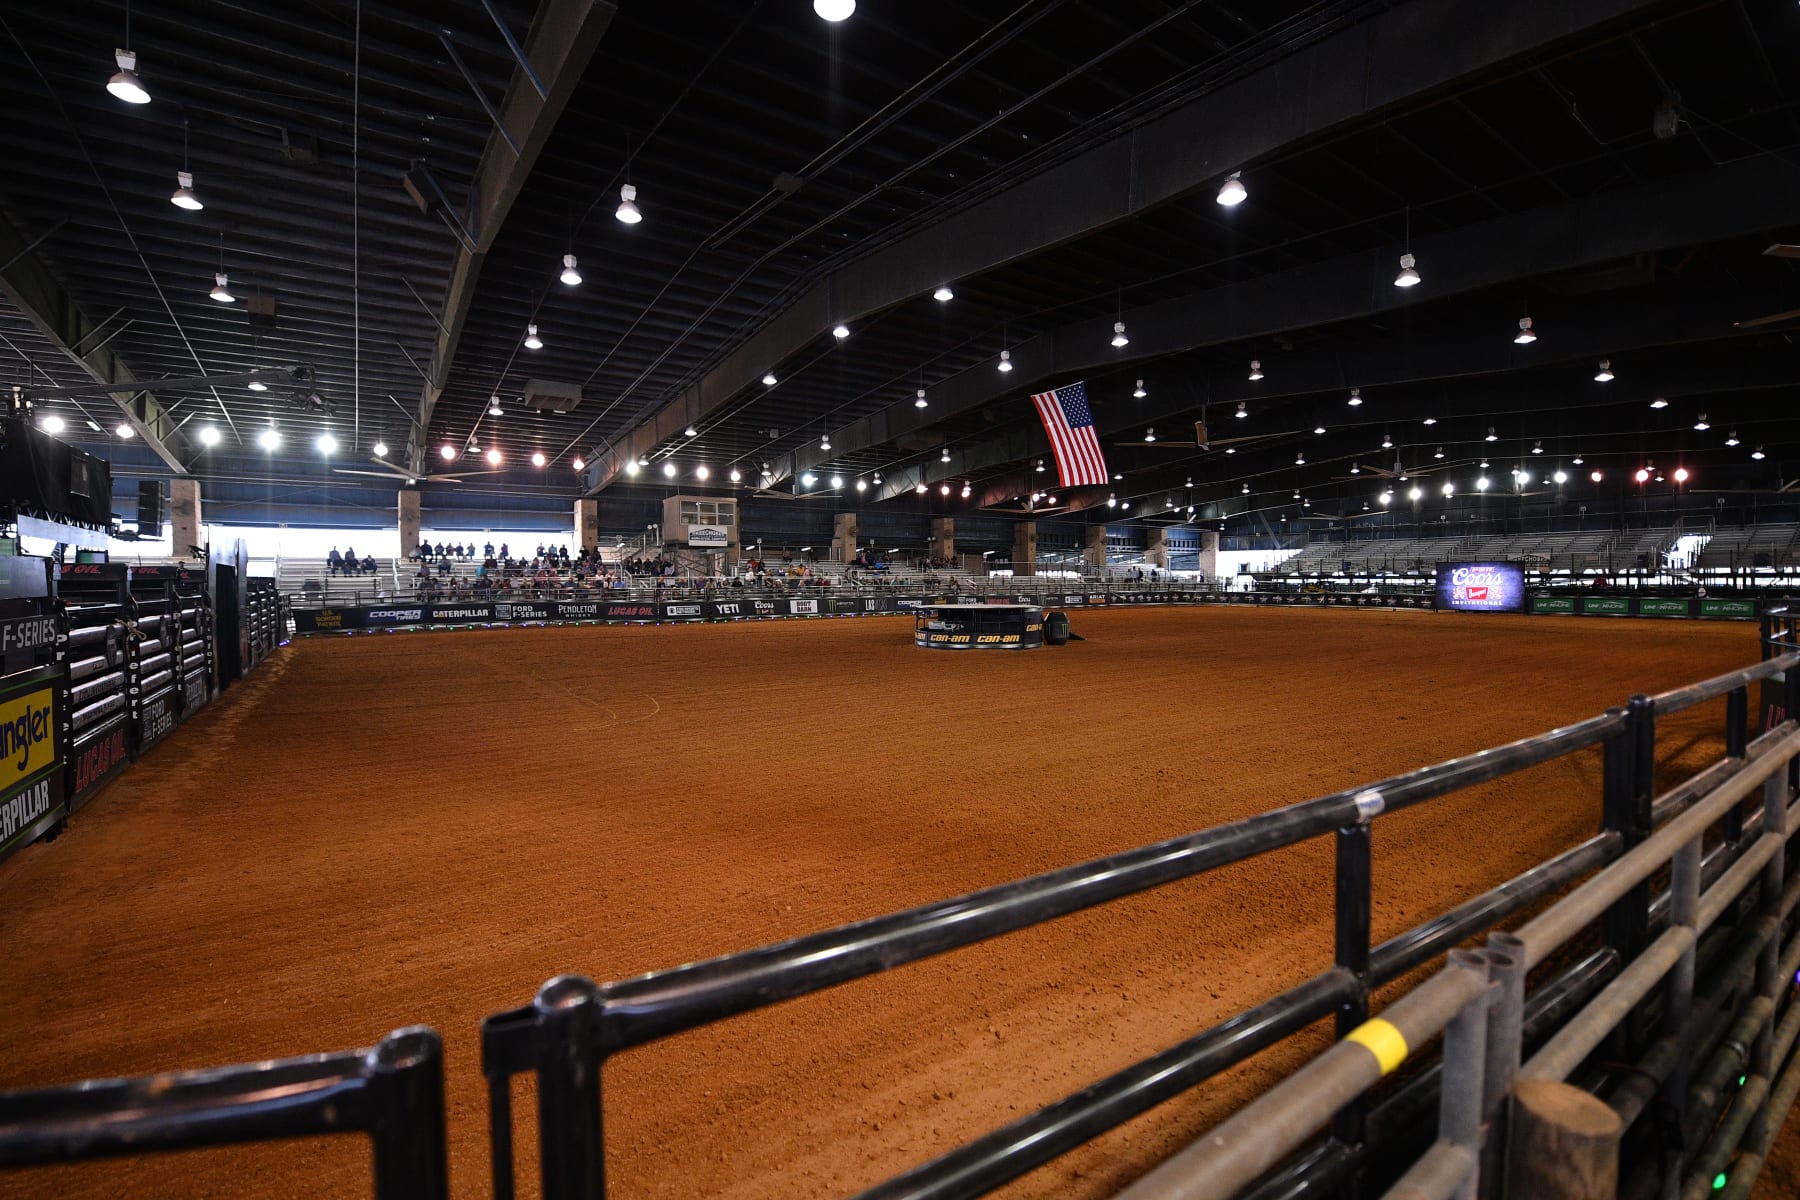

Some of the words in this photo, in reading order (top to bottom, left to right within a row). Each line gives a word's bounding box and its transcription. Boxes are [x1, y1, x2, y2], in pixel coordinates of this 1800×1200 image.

[1452, 568, 1503, 585] Coors
[558, 604, 597, 614] PENDLETON
[716, 604, 740, 614] YETI
[754, 600, 774, 608] Coors
[370, 609, 422, 618] COOPER
[432, 608, 489, 618] CATERPILLAR
[608, 607, 636, 616] LUCAS
[638, 607, 654, 616] OIL
[2, 618, 55, 651] F-SERIES
[930, 634, 970, 642] can-am
[977, 634, 1020, 643] can-am
[152, 699, 165, 720] FORD
[152, 711, 172, 739] F-SERIES
[0, 705, 50, 771] ngler
[76, 737, 110, 793] LUCAS
[112, 728, 126, 765] OIL
